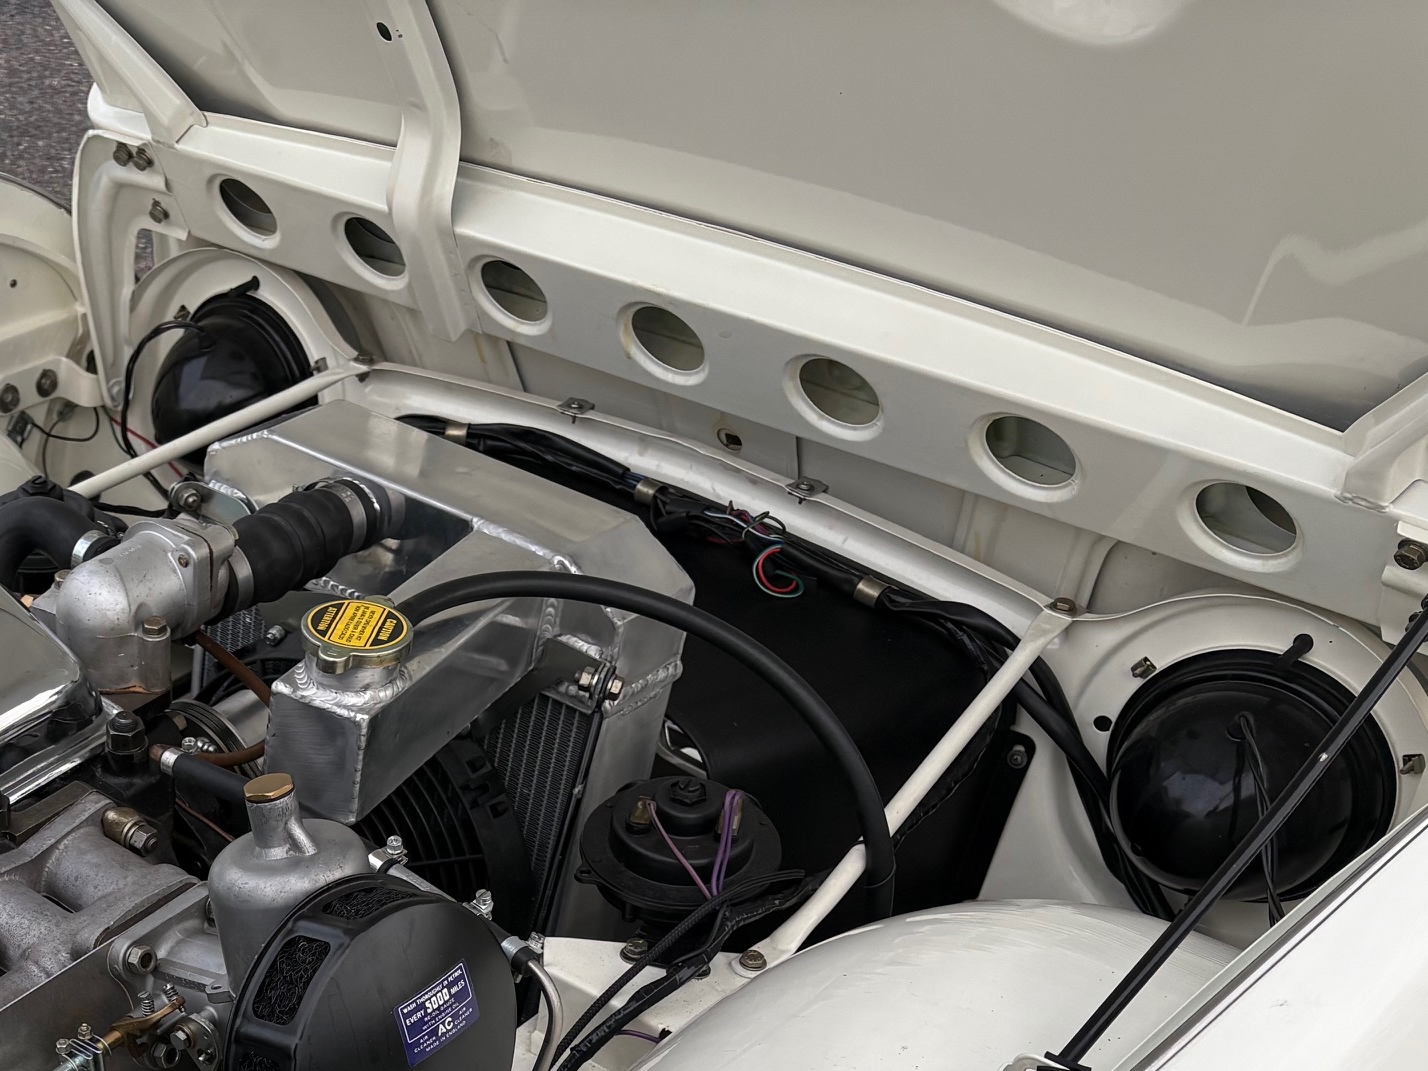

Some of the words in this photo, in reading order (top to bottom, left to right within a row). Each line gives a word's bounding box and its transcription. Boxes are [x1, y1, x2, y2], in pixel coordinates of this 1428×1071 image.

[406, 1009, 425, 1026] EVERY
[425, 988, 449, 1013] 5000
[451, 980, 465, 995] MILES
[455, 1008, 472, 1024] CLEANER
[426, 1041, 439, 1051] MADE
[446, 1021, 466, 1038] ENGLAND
[438, 1017, 453, 1036] AC
[414, 1037, 436, 1052] CLEANER
